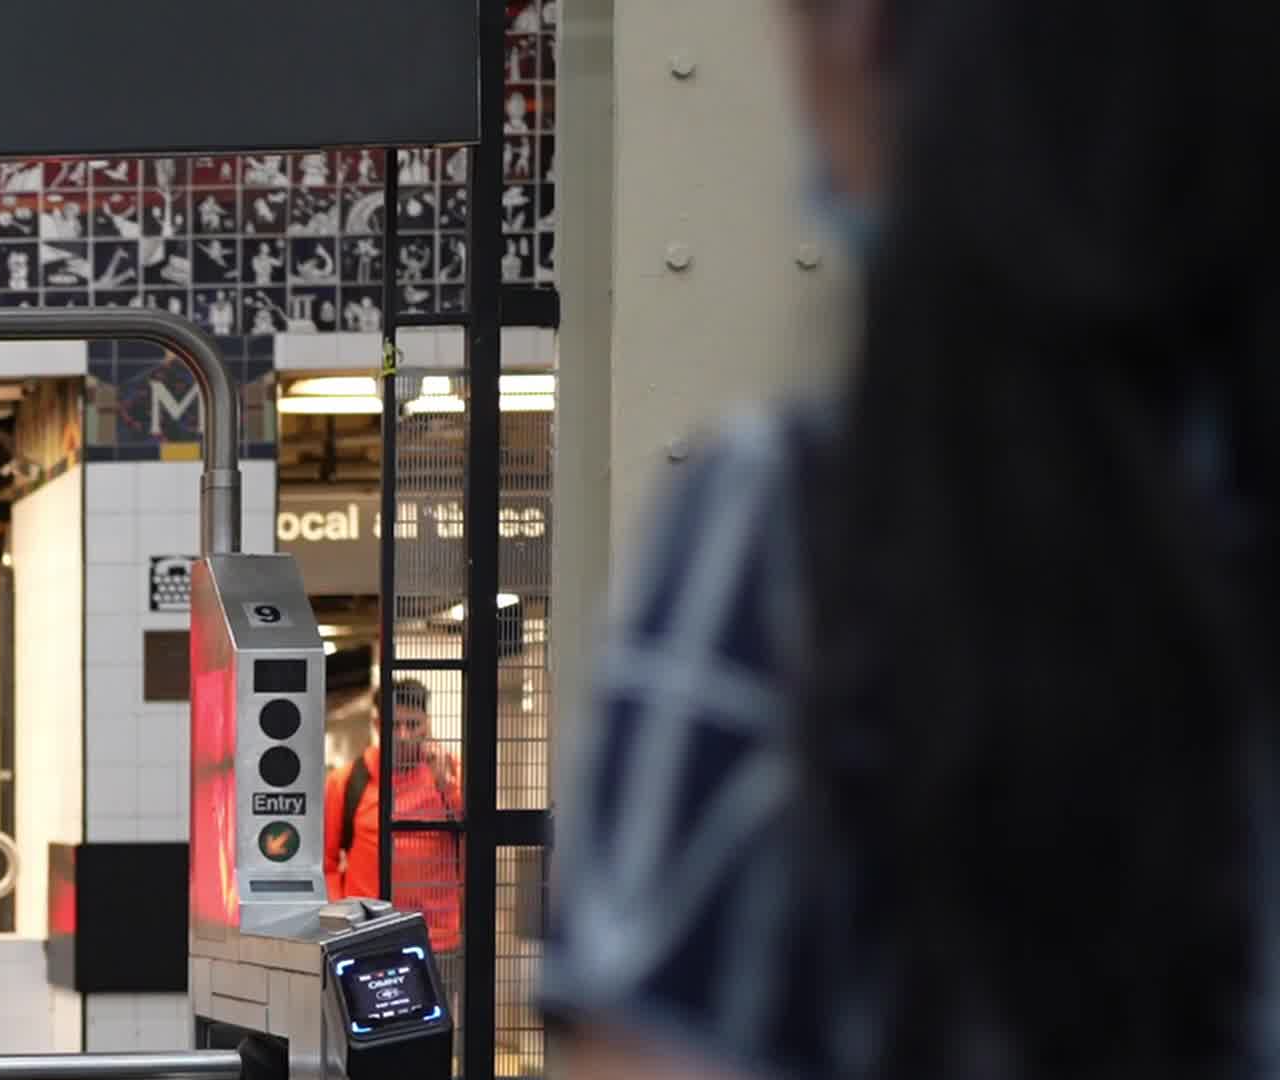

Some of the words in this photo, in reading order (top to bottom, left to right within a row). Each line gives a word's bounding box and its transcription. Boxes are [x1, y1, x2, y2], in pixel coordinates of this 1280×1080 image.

[149, 381, 205, 433] M
[276, 503, 359, 541] ocal
[255, 605, 281, 623] 9
[255, 795, 303, 814] Entry
